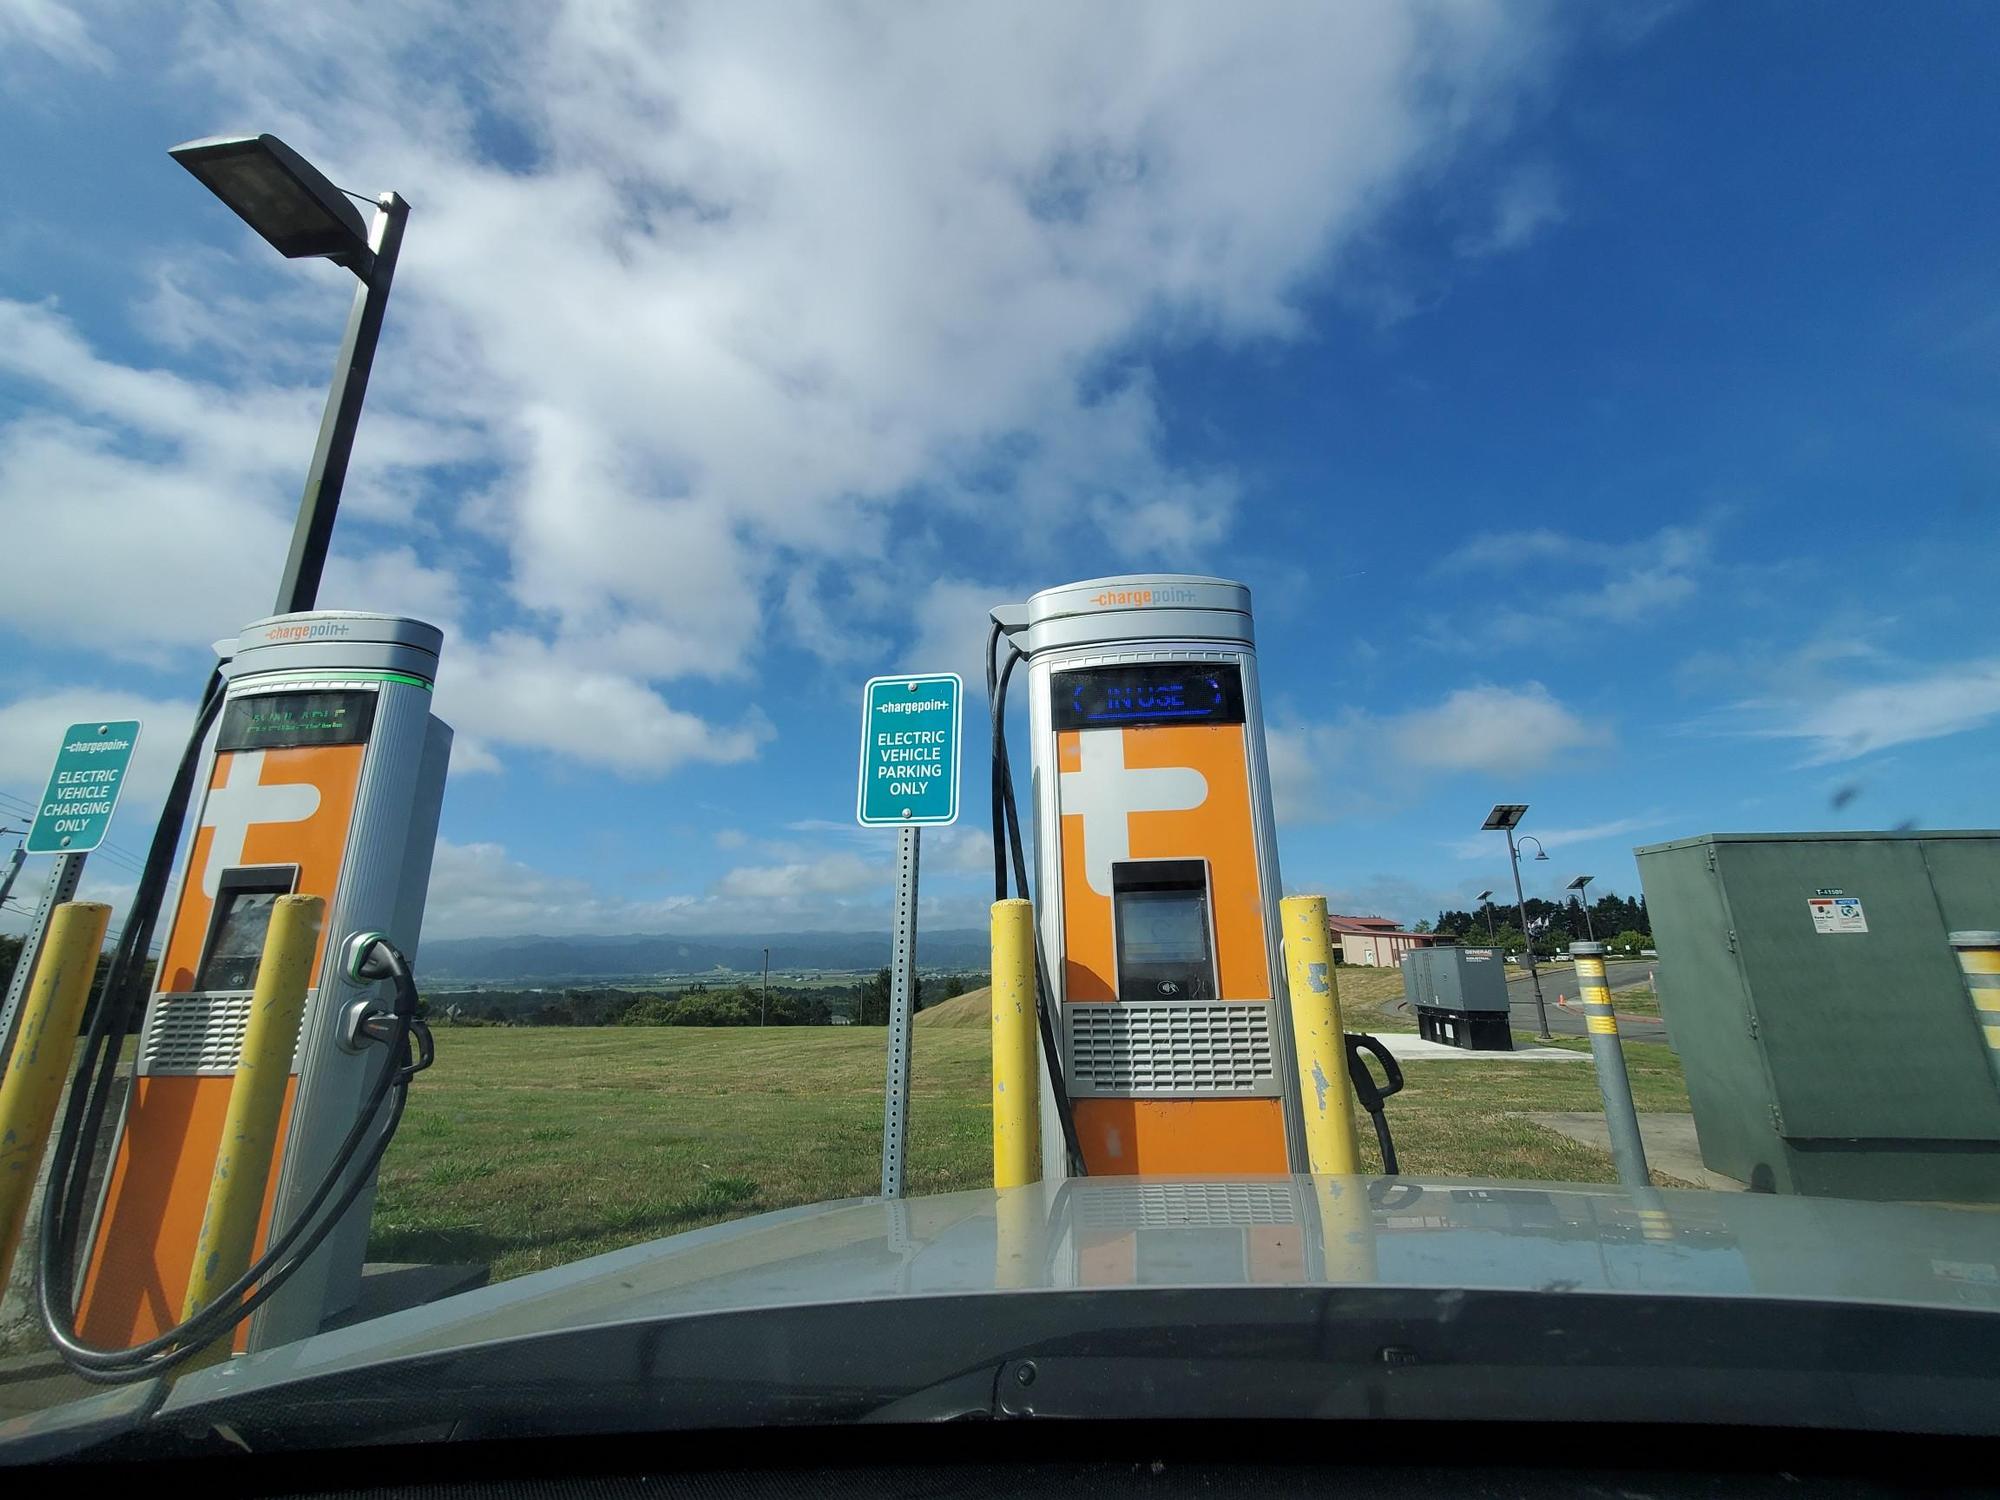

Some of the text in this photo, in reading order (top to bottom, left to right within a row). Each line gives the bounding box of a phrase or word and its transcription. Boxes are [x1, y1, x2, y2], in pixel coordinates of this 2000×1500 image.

[1107, 684, 1185, 709] IN USE
[878, 731, 945, 746] ELECTRIC
[880, 747, 941, 762] VEHICLE
[58, 769, 118, 784] ELECTRIC
[878, 764, 942, 779] PARKING
[56, 785, 110, 800] VEHICLE
[889, 781, 929, 796] ONLY
[44, 802, 111, 817] CHARGING
[55, 819, 91, 832] ONLY
